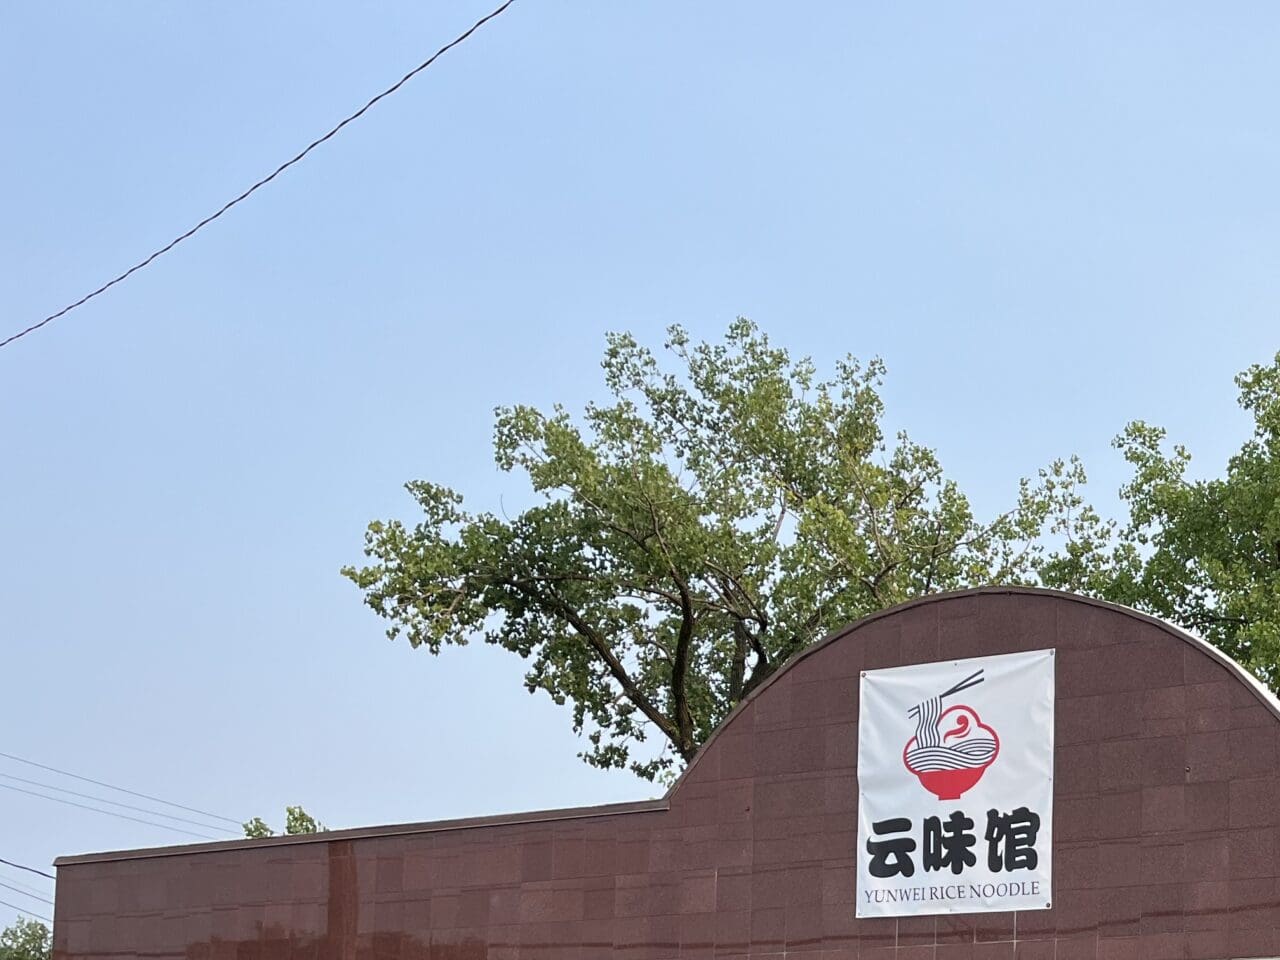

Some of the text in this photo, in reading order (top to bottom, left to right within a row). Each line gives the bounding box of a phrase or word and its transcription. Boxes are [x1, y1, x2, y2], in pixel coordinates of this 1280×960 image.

[866, 807, 1040, 878] 云味馆
[865, 881, 1040, 903] YUNWEI RICE NOODLE
